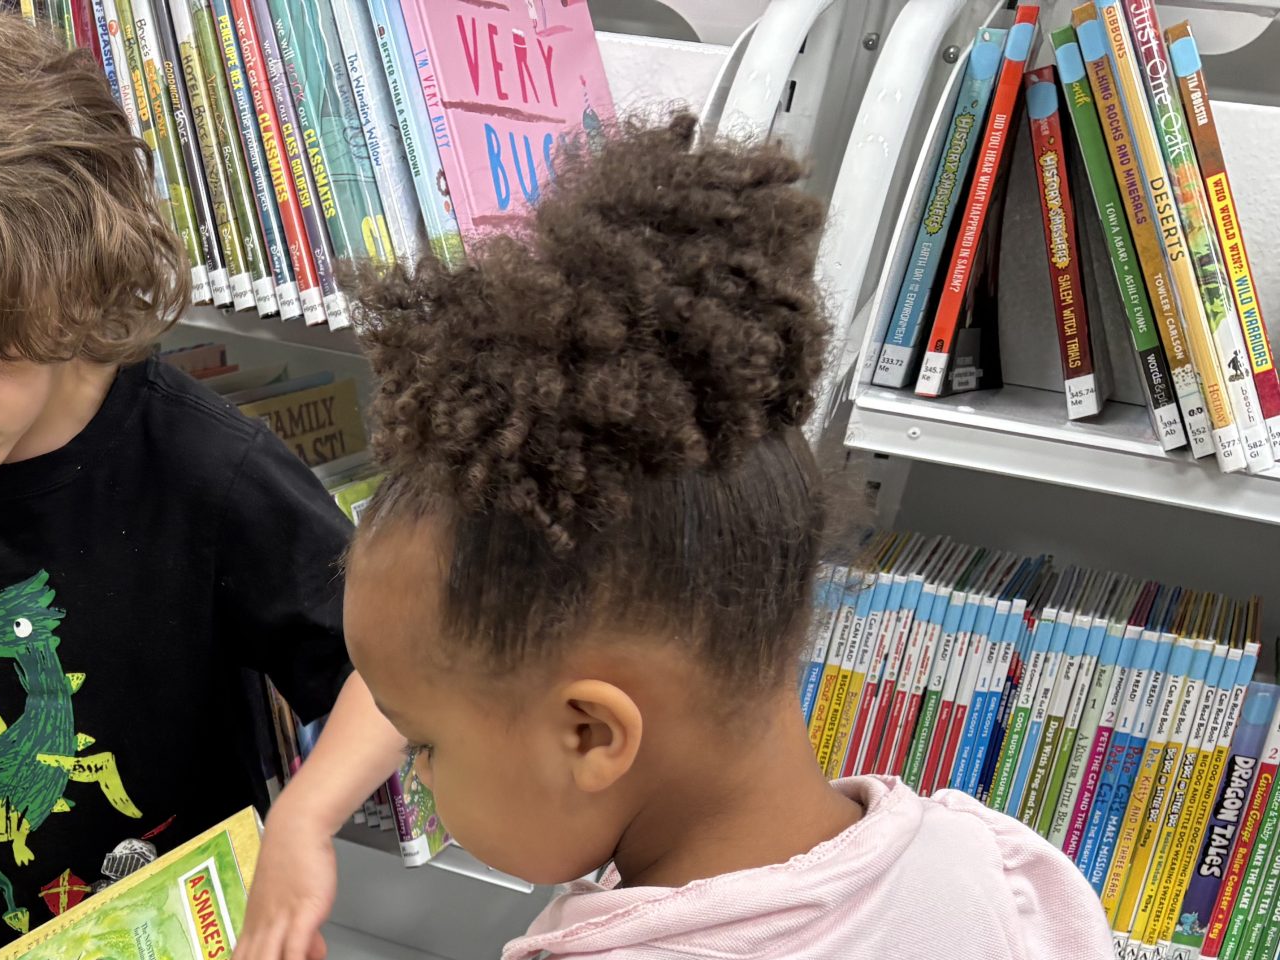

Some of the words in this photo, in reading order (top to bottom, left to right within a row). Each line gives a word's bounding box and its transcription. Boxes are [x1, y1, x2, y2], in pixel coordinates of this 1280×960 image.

[96, 15, 114, 66] SPLASH
[216, 15, 239, 68] PENELOPE
[1104, 5, 1127, 60] GIBBONS
[1128, 0, 1160, 55] Just
[240, 36, 256, 67] don't
[279, 38, 293, 60] will
[347, 53, 361, 74] The
[378, 40, 395, 77] BETTER
[414, 48, 430, 68] I'M
[456, 14, 558, 107] VERY
[181, 54, 201, 101] HOTEL
[229, 68, 243, 90] REX
[247, 68, 259, 88] eat
[265, 56, 280, 82] don't
[1144, 56, 1176, 107] One
[163, 60, 182, 109] GOODNIGHT
[272, 82, 285, 103] lose
[389, 78, 403, 106] THAN
[420, 74, 441, 109] VERY
[235, 90, 248, 110] and
[252, 89, 263, 111] our
[277, 103, 288, 122] our
[352, 75, 373, 126] Winding
[397, 108, 405, 116] A
[152, 99, 167, 137] MOVE
[240, 110, 252, 127] the
[297, 105, 309, 127] our
[992, 112, 1007, 129] DID
[1104, 103, 1124, 142] ROCKS
[281, 122, 299, 157] CLASS
[431, 114, 452, 150] BUSY
[945, 114, 973, 170] HISTORY
[987, 129, 1002, 149] YOU
[1159, 110, 1190, 159] Oak
[242, 128, 261, 167] problem
[256, 112, 289, 203] CLASSMATES
[365, 127, 384, 167] Willow
[399, 119, 422, 178] TOUCHDOWN
[981, 148, 997, 174] HEAR
[1115, 143, 1131, 166] AND
[253, 167, 266, 189] with
[301, 127, 337, 219] CLASSMATES
[484, 123, 557, 211] BUS
[1042, 154, 1060, 206] HISTORY
[290, 158, 312, 208] GOLDFISH
[973, 173, 990, 201] WHAT
[1122, 168, 1148, 225] MINERALS
[1210, 177, 1226, 203] WHO
[257, 190, 270, 211] pets
[927, 171, 955, 228] SMASHERS
[961, 202, 983, 247] HAPPENED
[1149, 176, 1185, 262] DESERTS
[1217, 205, 1235, 240] WOULD
[1049, 207, 1068, 262] SMASHERS
[916, 241, 932, 267] EARTH
[958, 247, 970, 259] IN
[1103, 201, 1121, 234] TONYA
[1112, 234, 1128, 262] ABARI
[1122, 273, 1139, 305] ASHLEY
[1132, 306, 1147, 334] EVANS
[1226, 241, 1244, 275] WIN?:
[912, 267, 924, 281] DAY
[948, 257, 968, 293] SALEM?
[1057, 273, 1073, 305] SALEM
[1234, 275, 1254, 308] WILD
[891, 290, 917, 344] ENVIRONMENT
[1061, 306, 1077, 335] WITCH
[1153, 273, 1171, 311] TOWLER
[1165, 317, 1184, 359] CARLSON
[1065, 337, 1081, 368] TRIALS
[1242, 308, 1269, 369] WARRIORS
[881, 356, 904, 367] 333.72
[1206, 382, 1228, 423] HOLIDAY
[259, 397, 335, 440] FAMILY
[296, 431, 346, 468] AST!
[833, 673, 848, 707] BISCUIT
[827, 707, 839, 731] RIDES
[1013, 711, 1026, 733] COOL
[1043, 719, 1060, 745] Days
[822, 733, 833, 750] THE
[1037, 744, 1053, 767] With
[1095, 730, 1108, 753] PETE
[1213, 748, 1224, 763] BIG
[1090, 754, 1102, 773] THE
[1120, 744, 1141, 776] Pete
[1198, 753, 1209, 768] BIG
[1208, 762, 1220, 781] DOG
[996, 758, 1013, 797] TREASURE
[1030, 767, 1047, 790] Frog
[1084, 773, 1097, 792] CAT
[1132, 773, 1152, 804] Kitty
[1193, 767, 1205, 786] DOG
[1202, 781, 1214, 799] AND
[1216, 752, 1257, 825] DRAGON
[1250, 771, 1273, 811] Curious
[1026, 790, 1039, 808] and
[1079, 793, 1091, 812] AND
[1187, 786, 1199, 805] AND
[1073, 812, 1085, 830] THE
[1127, 804, 1141, 824] AND
[1179, 804, 1194, 831] LITTLE
[1194, 799, 1208, 826] LITTLE
[1238, 808, 1261, 844] George
[1101, 815, 1119, 844] MARS
[1122, 826, 1134, 843] THE
[1174, 830, 1186, 848] DOG
[1189, 825, 1201, 843] DOG
[1089, 846, 1109, 886] MISSION
[1113, 844, 1129, 870] THREE
[1164, 848, 1180, 884] WEARING
[1179, 843, 1195, 877] GETTING
[1230, 845, 1246, 873] Roller
[1252, 842, 1266, 865] BAKE
[189, 875, 205, 889] A
[1104, 871, 1121, 900] BEARS
[1176, 878, 1185, 888] IN
[1246, 865, 1260, 884] THE
[1262, 876, 1276, 897] THE
[1152, 884, 1169, 923] SWEATERS
[1166, 888, 1182, 921] TROUBLE
[1218, 874, 1238, 911] Coaster
[1238, 885, 1254, 910] CAKE
[1257, 897, 1270, 916] TEA
[192, 889, 225, 959] SNAKE'S
[1208, 921, 1223, 940] Rey
